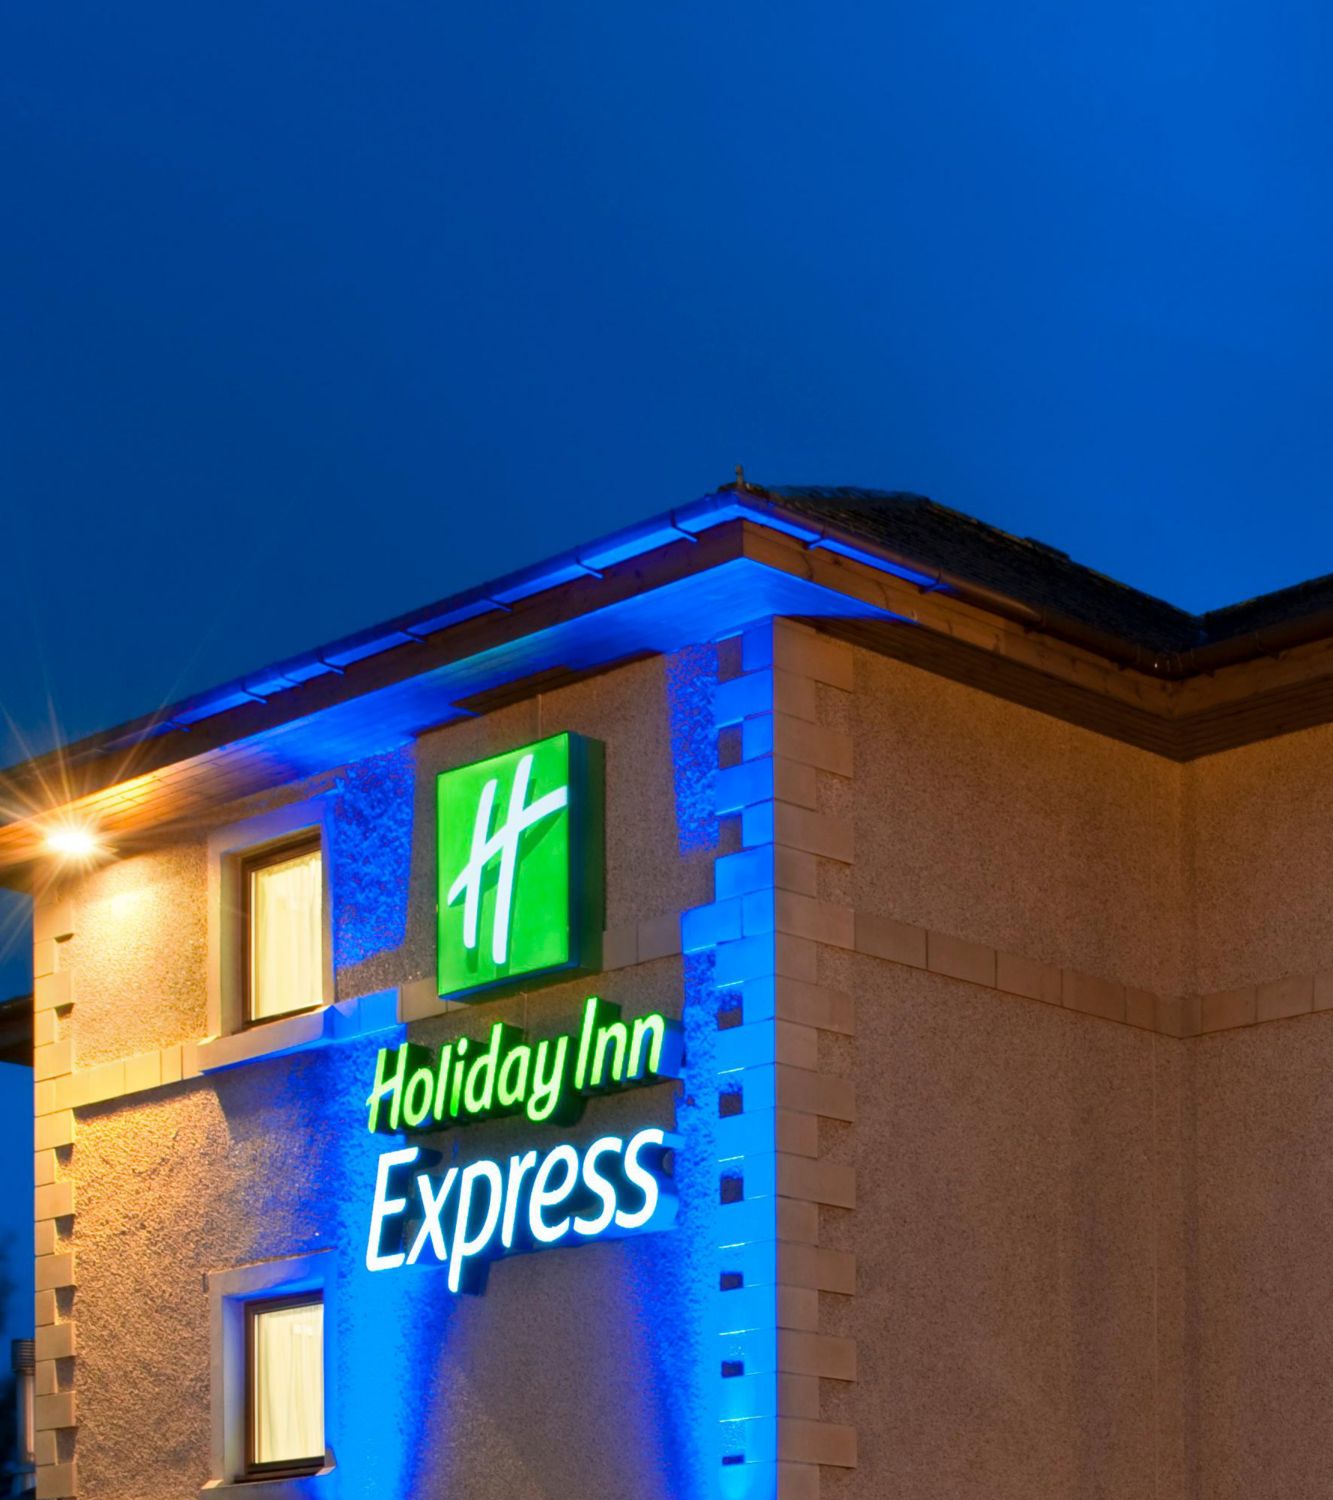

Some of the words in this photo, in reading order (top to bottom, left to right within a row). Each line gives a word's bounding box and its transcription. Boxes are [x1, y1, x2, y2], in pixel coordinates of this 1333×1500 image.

[365, 1022, 568, 1134] Holiday
[574, 996, 666, 1090] Inn
[365, 1127, 665, 1293] Express
